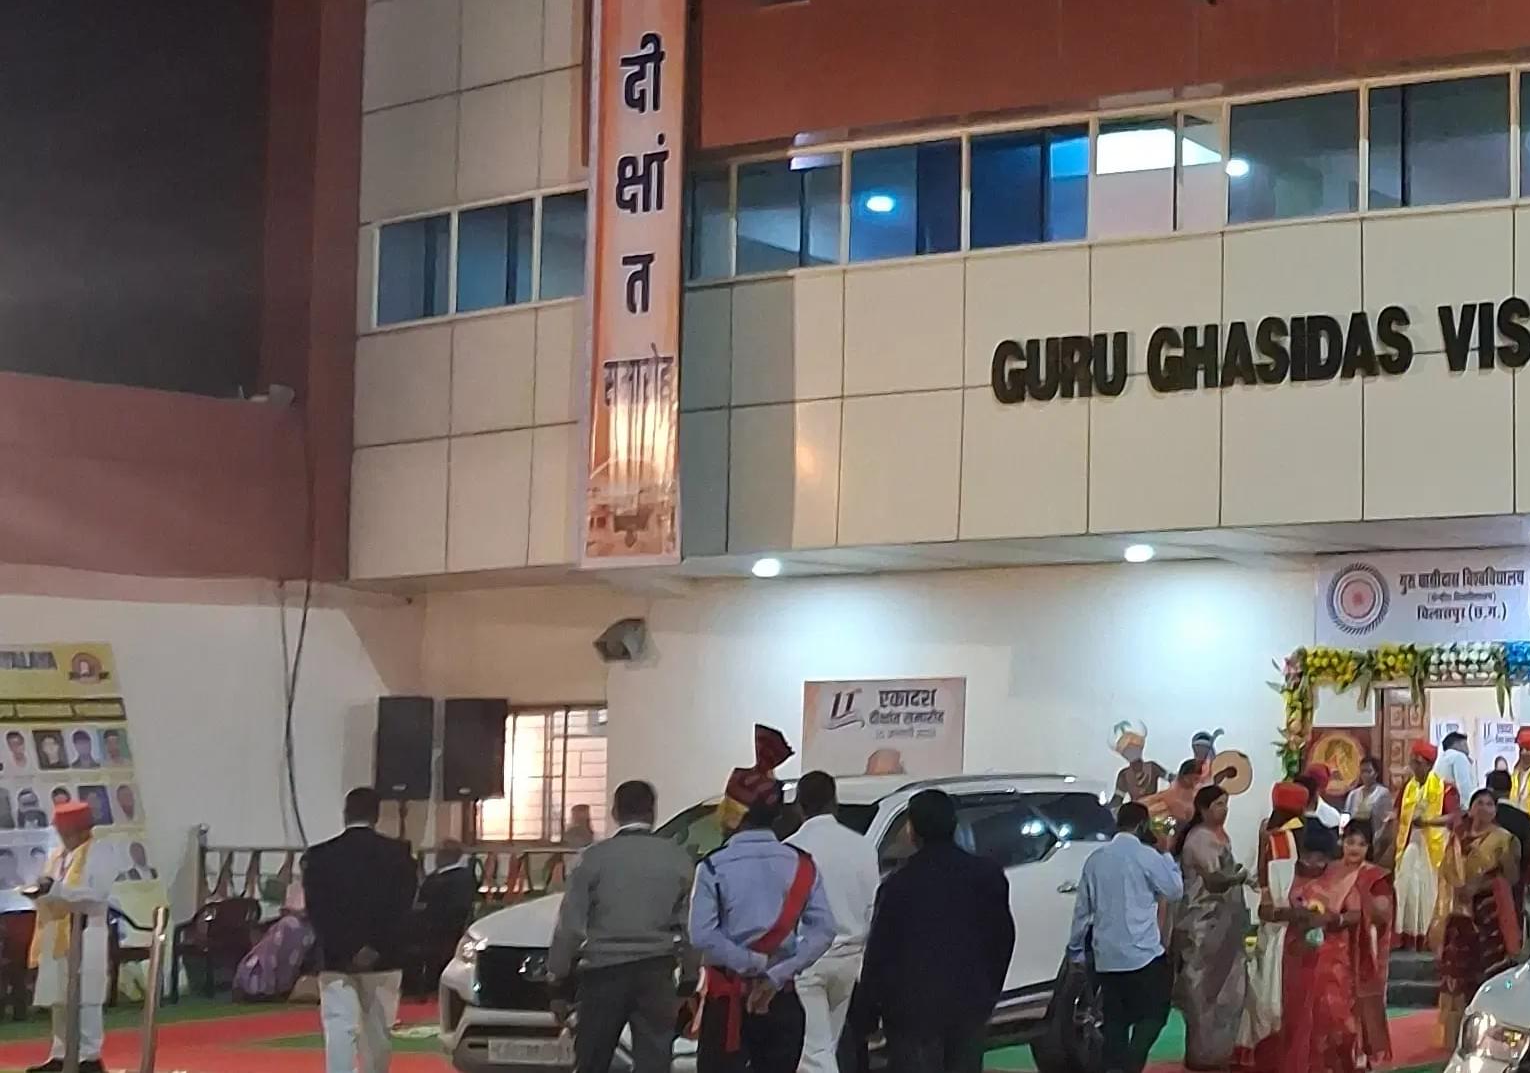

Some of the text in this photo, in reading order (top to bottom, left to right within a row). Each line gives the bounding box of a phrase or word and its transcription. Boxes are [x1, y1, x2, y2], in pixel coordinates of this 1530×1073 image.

[615, 33, 668, 313] दीक्षांत
[992, 331, 1129, 404] GURU
[1147, 305, 1413, 392] GHASIDAS
